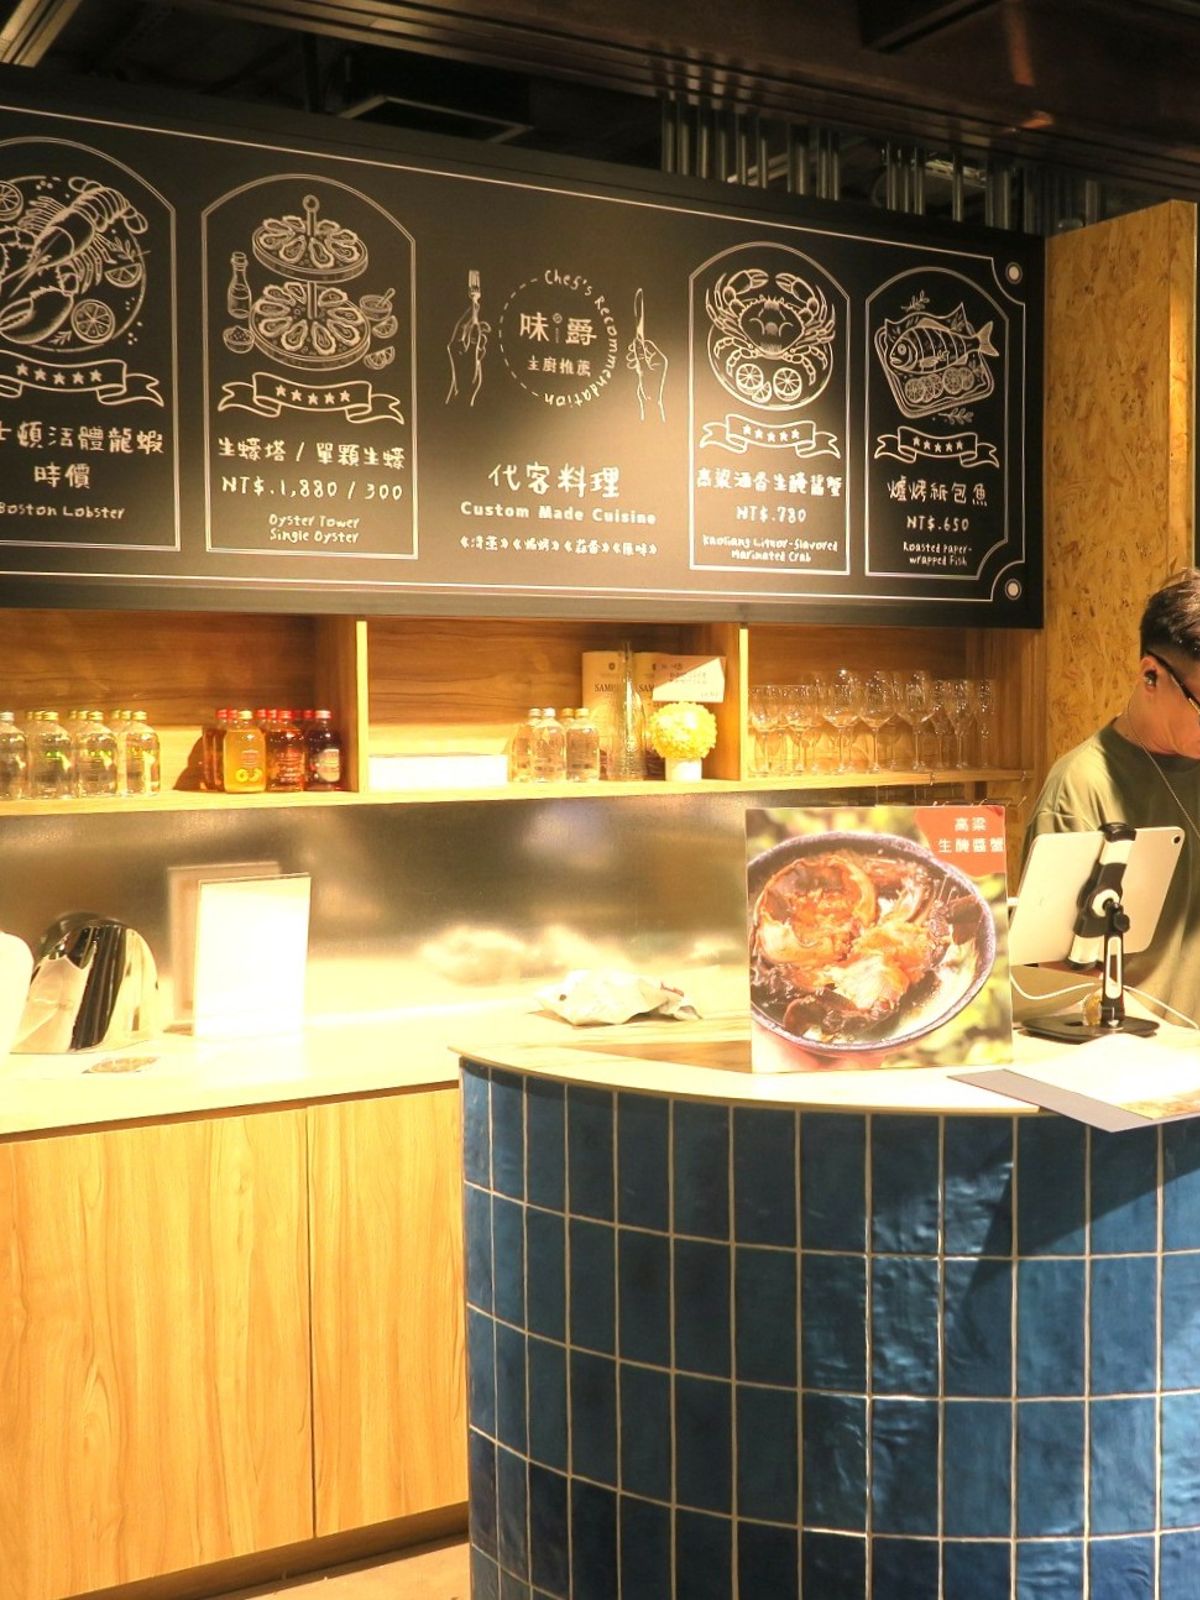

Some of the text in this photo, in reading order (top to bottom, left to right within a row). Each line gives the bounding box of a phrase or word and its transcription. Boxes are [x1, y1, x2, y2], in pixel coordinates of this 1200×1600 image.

[519, 311, 598, 346] 味爵
[527, 355, 592, 377] 主廚推薦
[218, 437, 286, 461] 生蠔塔
[317, 442, 406, 470] 單顆生蠔
[34, 462, 90, 489] 時價
[488, 461, 620, 498] 代客料理
[365, 483, 403, 501] 300
[887, 475, 988, 507] 爐烤紙包魚
[63, 506, 125, 520] Lobster
[269, 513, 360, 529] Oyster Tower
[460, 501, 657, 525] Custom Made Cuisine
[269, 528, 359, 544] Single Oyster
